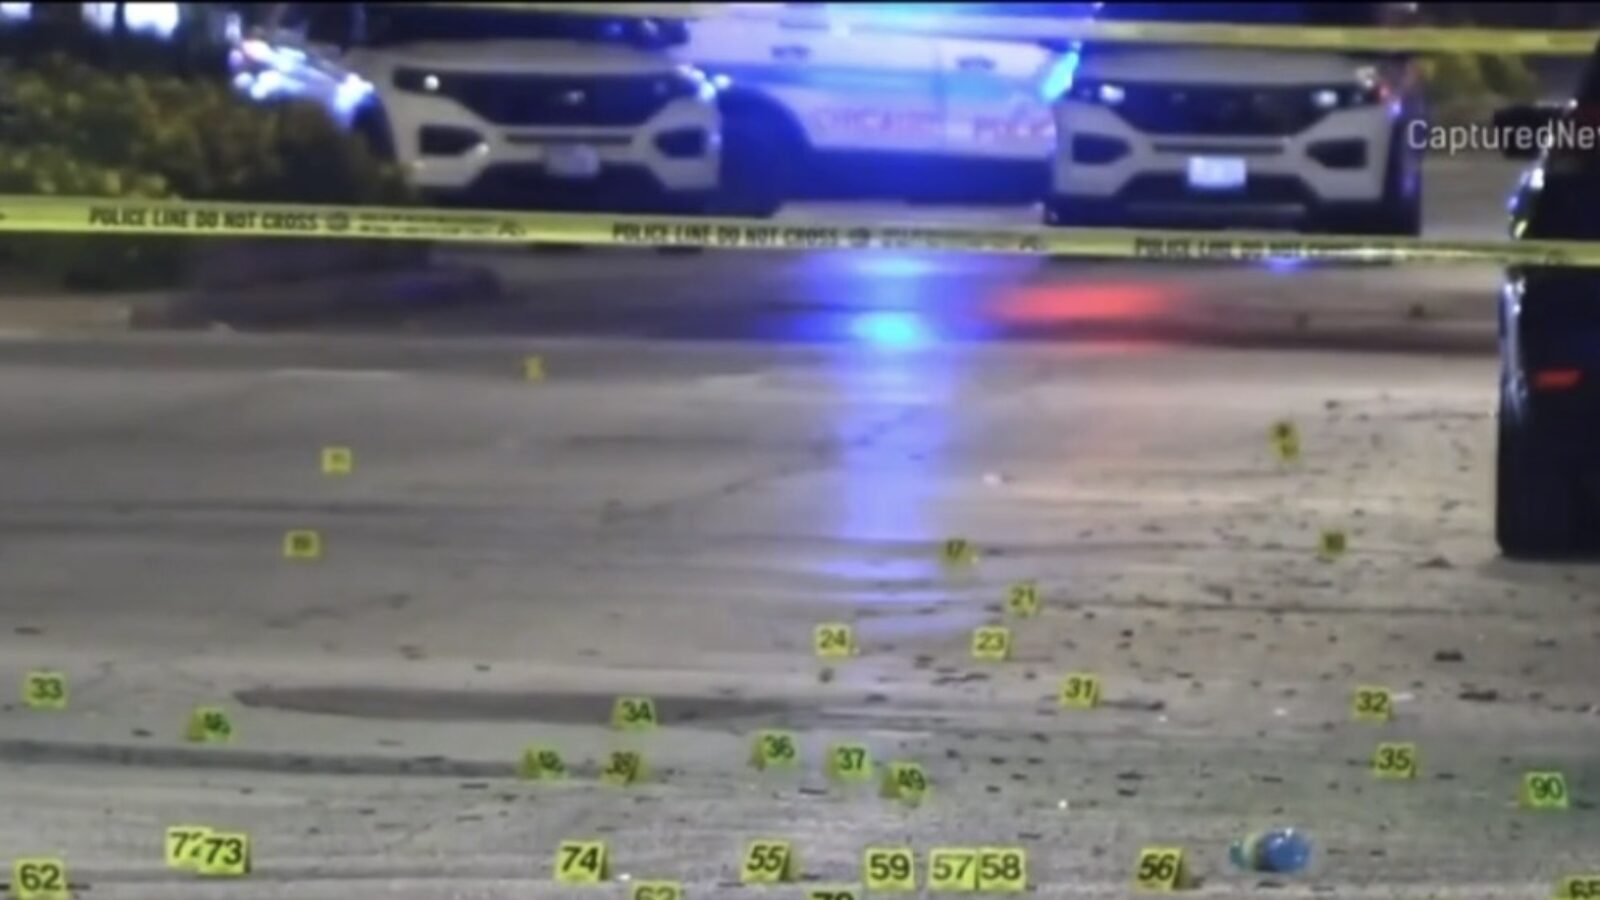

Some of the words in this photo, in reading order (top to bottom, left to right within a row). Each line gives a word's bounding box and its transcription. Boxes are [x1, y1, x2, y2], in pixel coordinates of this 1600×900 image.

[88, 207, 147, 226] POLICE
[152, 208, 188, 228] LINE
[195, 211, 219, 229] DO
[223, 211, 257, 229] NOT
[261, 212, 319, 230] CROSS
[612, 223, 669, 243] POLICE
[674, 224, 711, 244] LINE
[717, 225, 741, 245] DO
[745, 226, 779, 245] NOT
[783, 227, 839, 246] CROSS
[1010, 587, 1035, 607] 21
[819, 628, 846, 649] 24
[976, 630, 1005, 652] 23
[30, 677, 64, 701] 33
[1064, 676, 1094, 700] 31
[621, 700, 653, 723] 34
[1357, 690, 1388, 713] 32
[763, 733, 796, 760] 36
[836, 746, 866, 772] 37
[1378, 747, 1411, 772] 35
[1529, 775, 1564, 802] 90
[204, 837, 243, 866] 73
[560, 845, 599, 873] 74
[746, 844, 784, 873] 55
[20, 862, 61, 892] 62
[869, 853, 910, 882] 59
[932, 853, 974, 881] 57
[981, 852, 1021, 882] 58
[1138, 853, 1176, 881] 56
